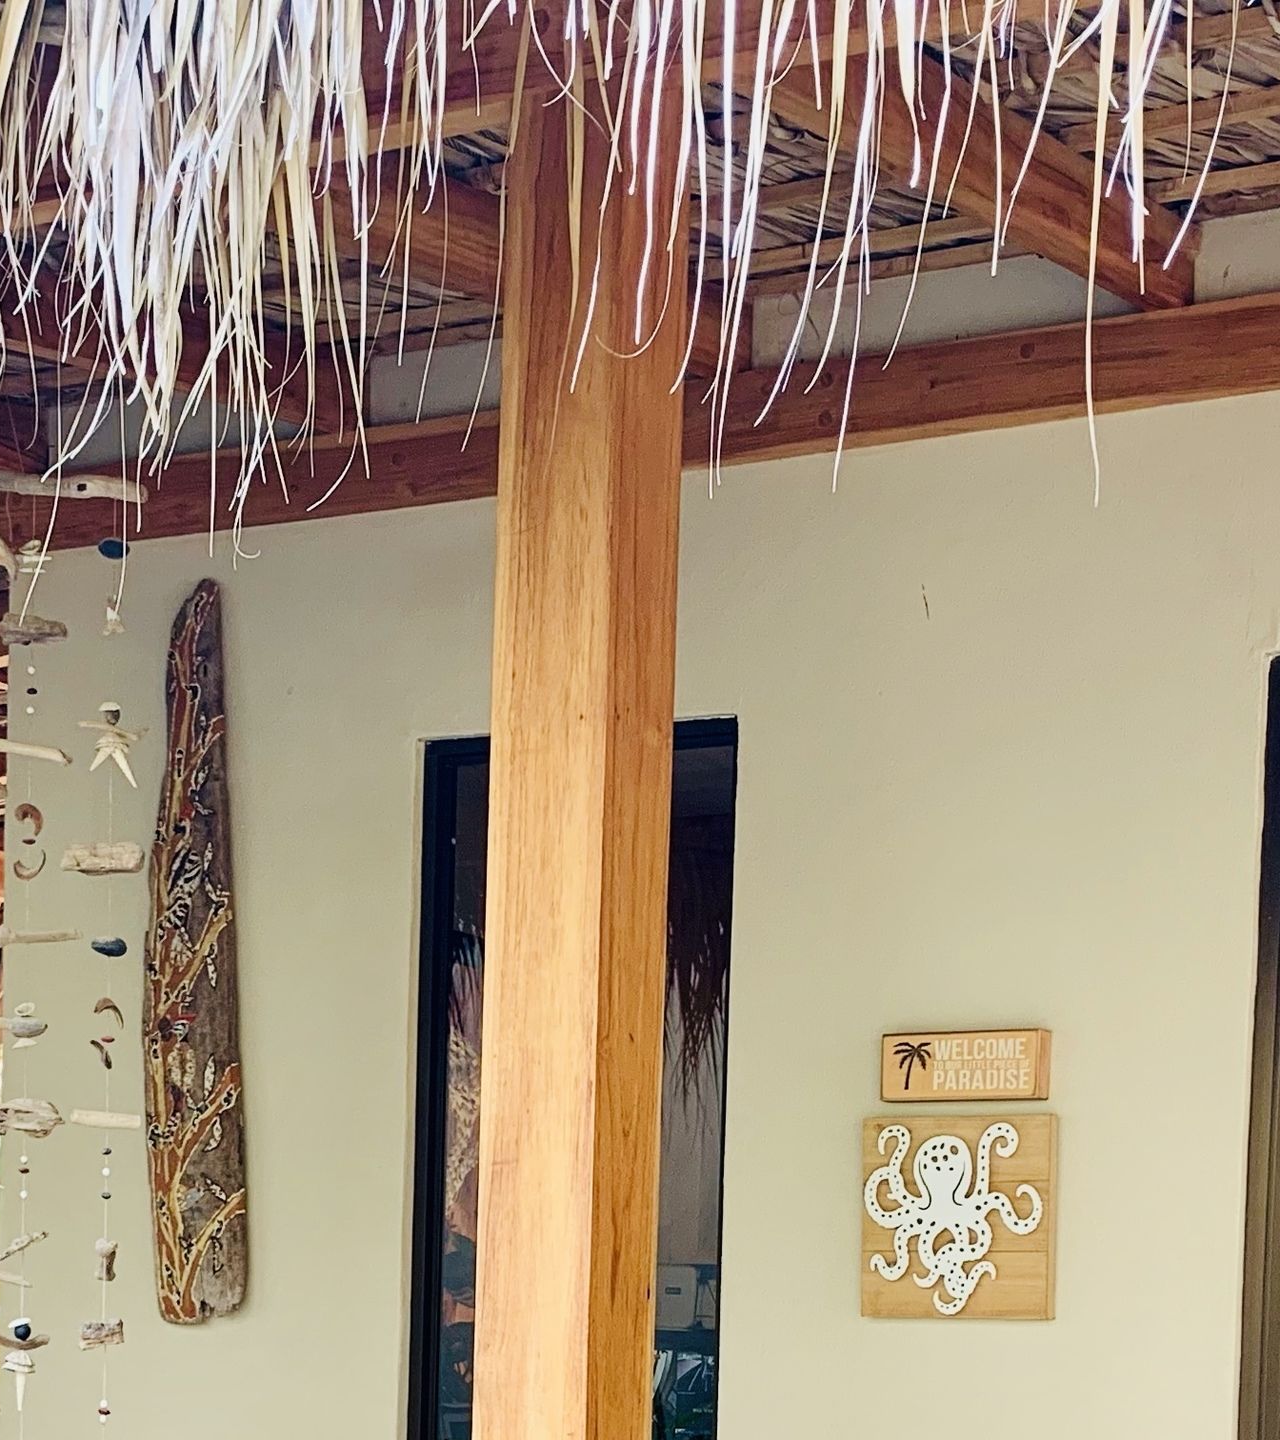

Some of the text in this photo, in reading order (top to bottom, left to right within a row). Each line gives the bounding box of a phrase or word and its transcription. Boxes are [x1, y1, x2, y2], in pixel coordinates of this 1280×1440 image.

[934, 1037, 1027, 1061] WELCOME
[933, 1060, 944, 1070] TO
[963, 1060, 992, 1070] LITTLE
[932, 1068, 1031, 1091] PARADISE
